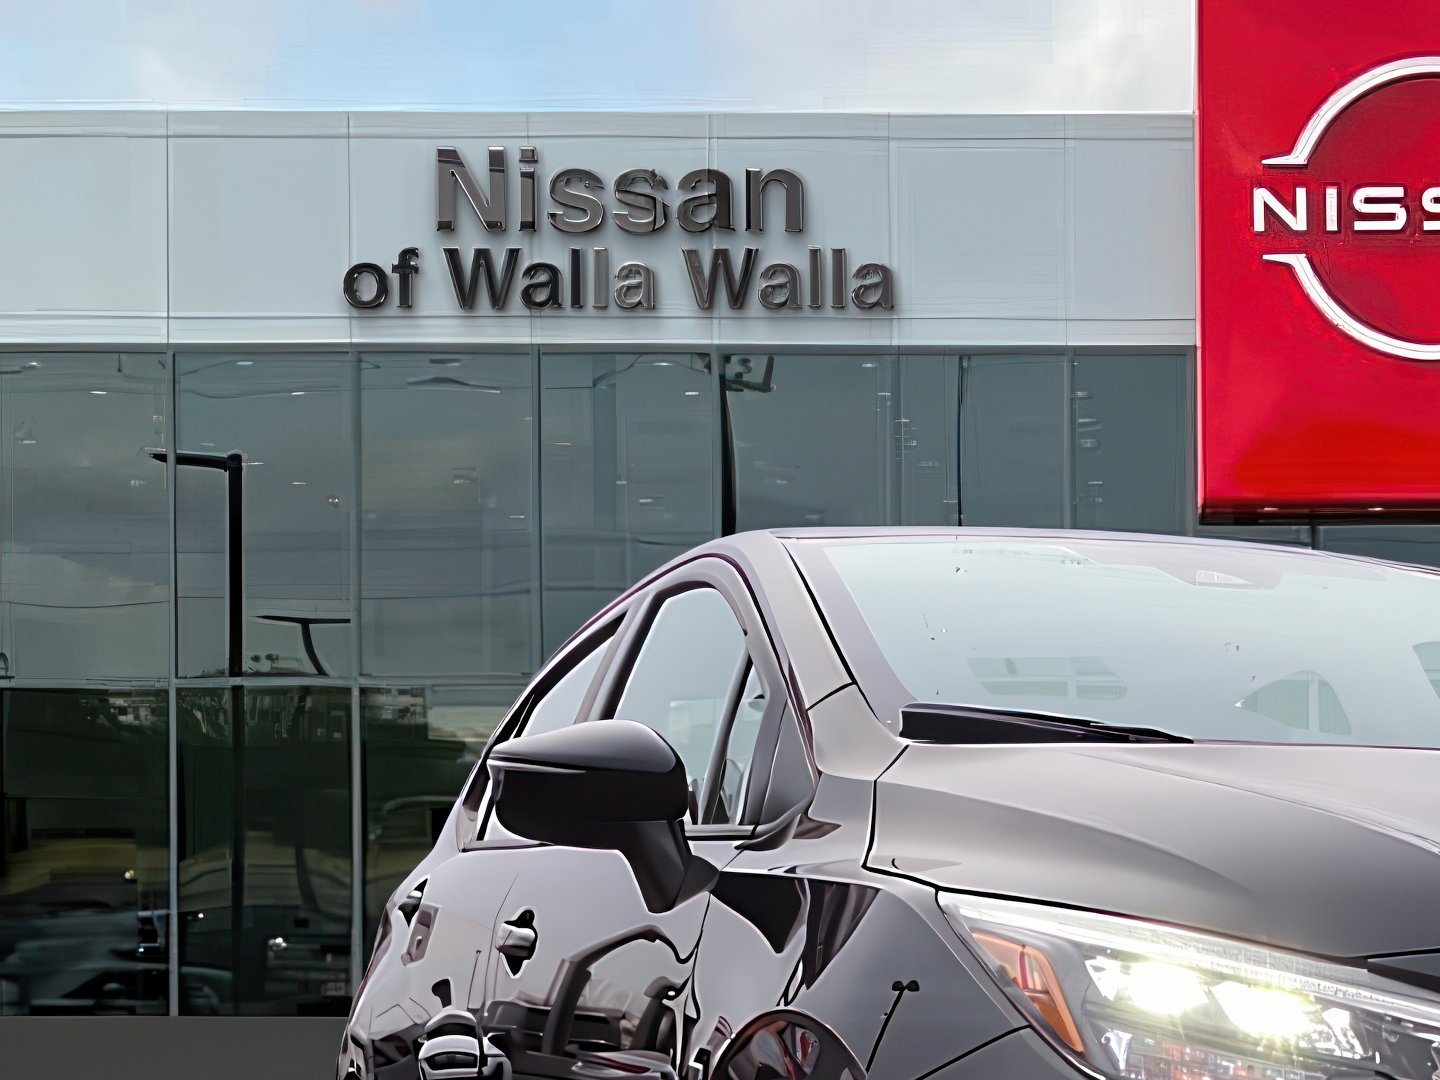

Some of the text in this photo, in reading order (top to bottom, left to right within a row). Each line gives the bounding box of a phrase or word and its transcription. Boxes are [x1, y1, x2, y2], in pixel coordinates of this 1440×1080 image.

[434, 144, 806, 234] Nissan
[342, 246, 897, 311] of Walla Walla
